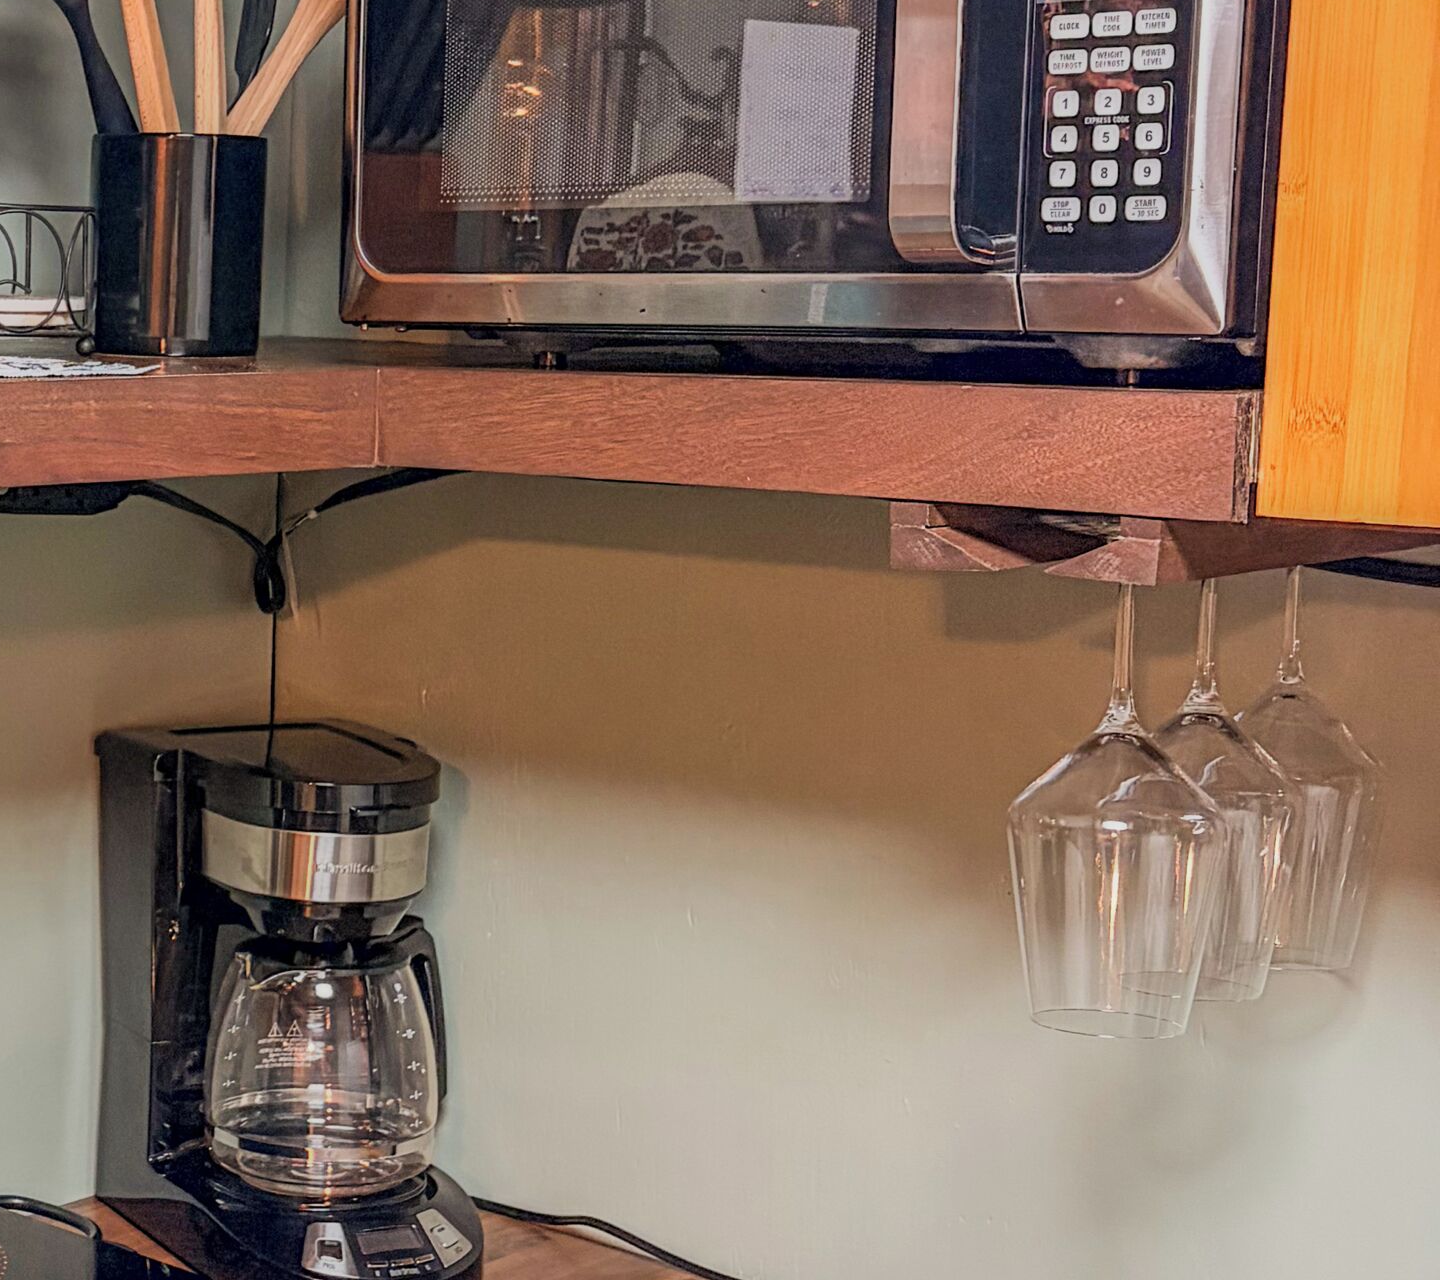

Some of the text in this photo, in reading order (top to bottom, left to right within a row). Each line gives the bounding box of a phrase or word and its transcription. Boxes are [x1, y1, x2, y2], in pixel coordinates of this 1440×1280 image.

[1104, 15, 1120, 23] TIME
[1141, 12, 1171, 21] KITCHEN
[1059, 22, 1080, 30] CLOCK
[1102, 24, 1121, 32] COOK
[1145, 21, 1166, 29] TIMER
[1059, 53, 1076, 61] TIME
[1097, 50, 1124, 59] WEIGHT
[1141, 48, 1166, 57] POWER
[1053, 62, 1082, 70] DEFROST
[1095, 60, 1124, 68] DEFROST
[1143, 57, 1162, 66] LEVEL
[1062, 98, 1068, 110] 1
[1104, 96, 1112, 108] 2
[1147, 94, 1155, 106] 3
[1084, 115, 1130, 125] EXPRESS COOK
[1060, 133, 1068, 145] 4
[1102, 131, 1110, 143] 5
[1145, 130, 1153, 142] 6
[1059, 168, 1067, 180] 7
[1100, 167, 1108, 179] 8
[1143, 166, 1151, 178] 9
[1052, 200, 1070, 209] STOP
[1134, 198, 1157, 207] START
[1098, 203, 1106, 215] 0
[1050, 210, 1071, 218] CLEAR
